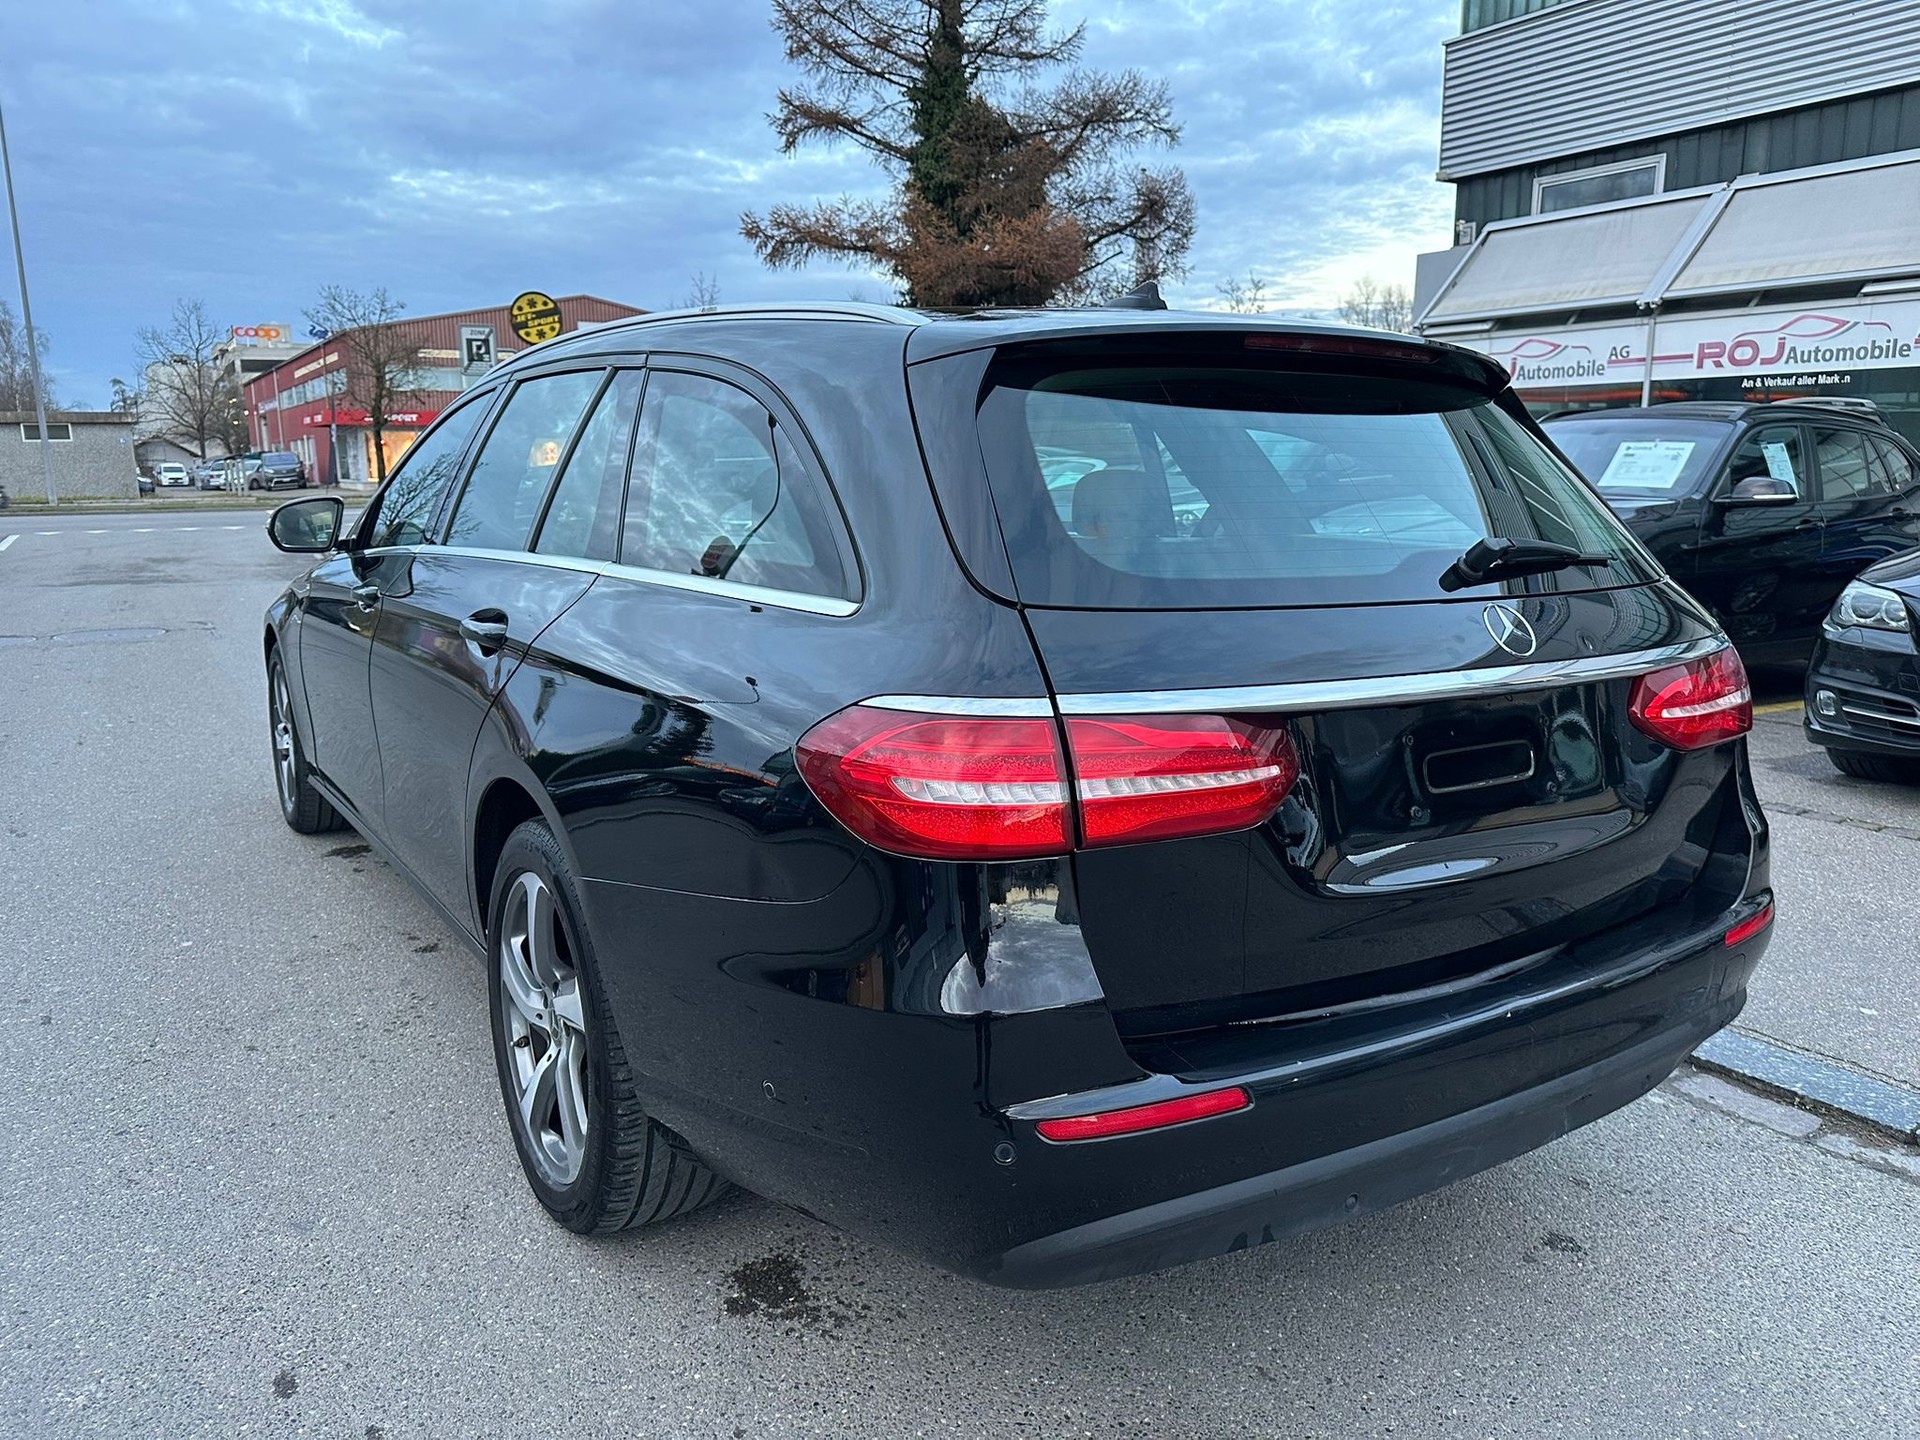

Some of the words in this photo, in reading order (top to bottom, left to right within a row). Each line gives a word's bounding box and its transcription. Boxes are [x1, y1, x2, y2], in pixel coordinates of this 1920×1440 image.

[527, 314, 560, 327] SPORT
[234, 327, 280, 341] coop
[1784, 338, 1911, 365] Automobile
[1516, 360, 1605, 381] Automobile
[1608, 345, 1631, 359] AG
[1741, 378, 1754, 388] An
[1755, 377, 1762, 387] &
[1763, 375, 1796, 387] Verkauf
[1797, 375, 1817, 385] aller
[1818, 374, 1851, 384] Markn
